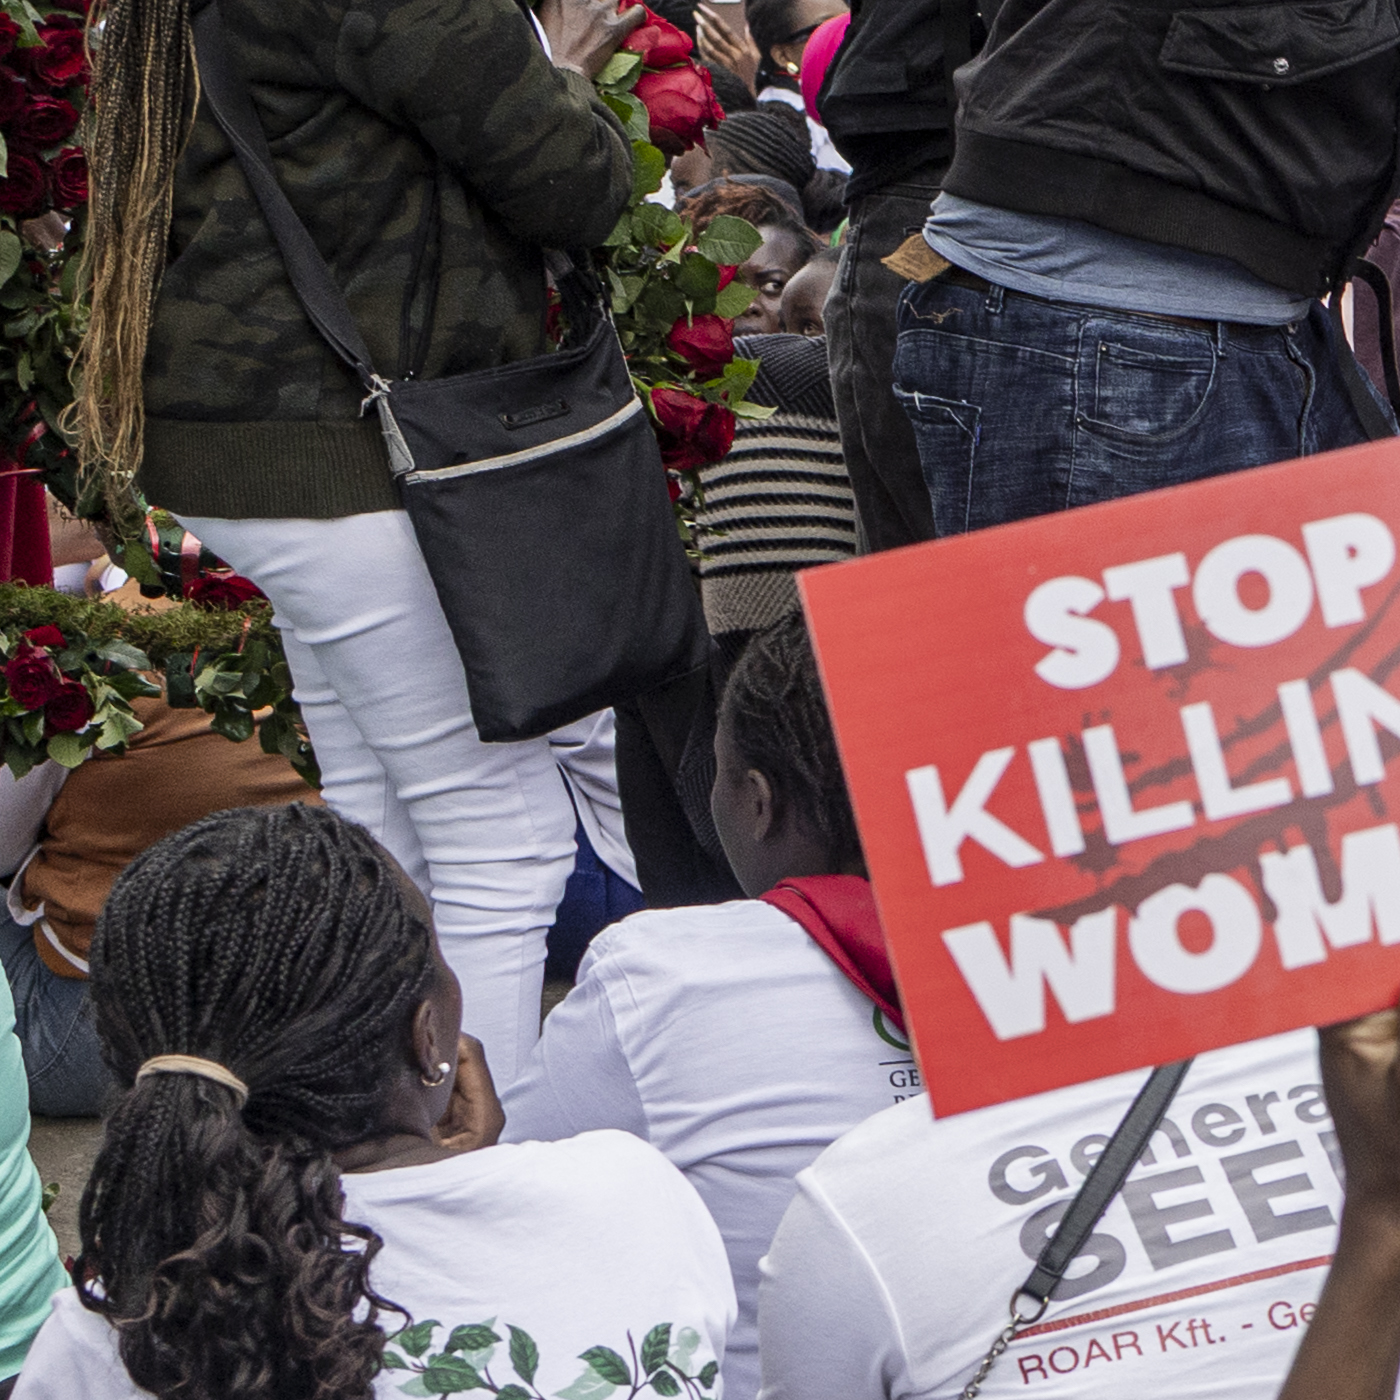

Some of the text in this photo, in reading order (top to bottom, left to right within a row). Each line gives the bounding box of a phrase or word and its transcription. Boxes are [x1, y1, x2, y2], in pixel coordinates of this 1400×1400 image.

[1022, 511, 1400, 691] STOP
[988, 1082, 1334, 1207] Genera
[1018, 1130, 1346, 1302] SEE
[1017, 1329, 1143, 1386] ROAR
[1155, 1315, 1228, 1354] Kft.
